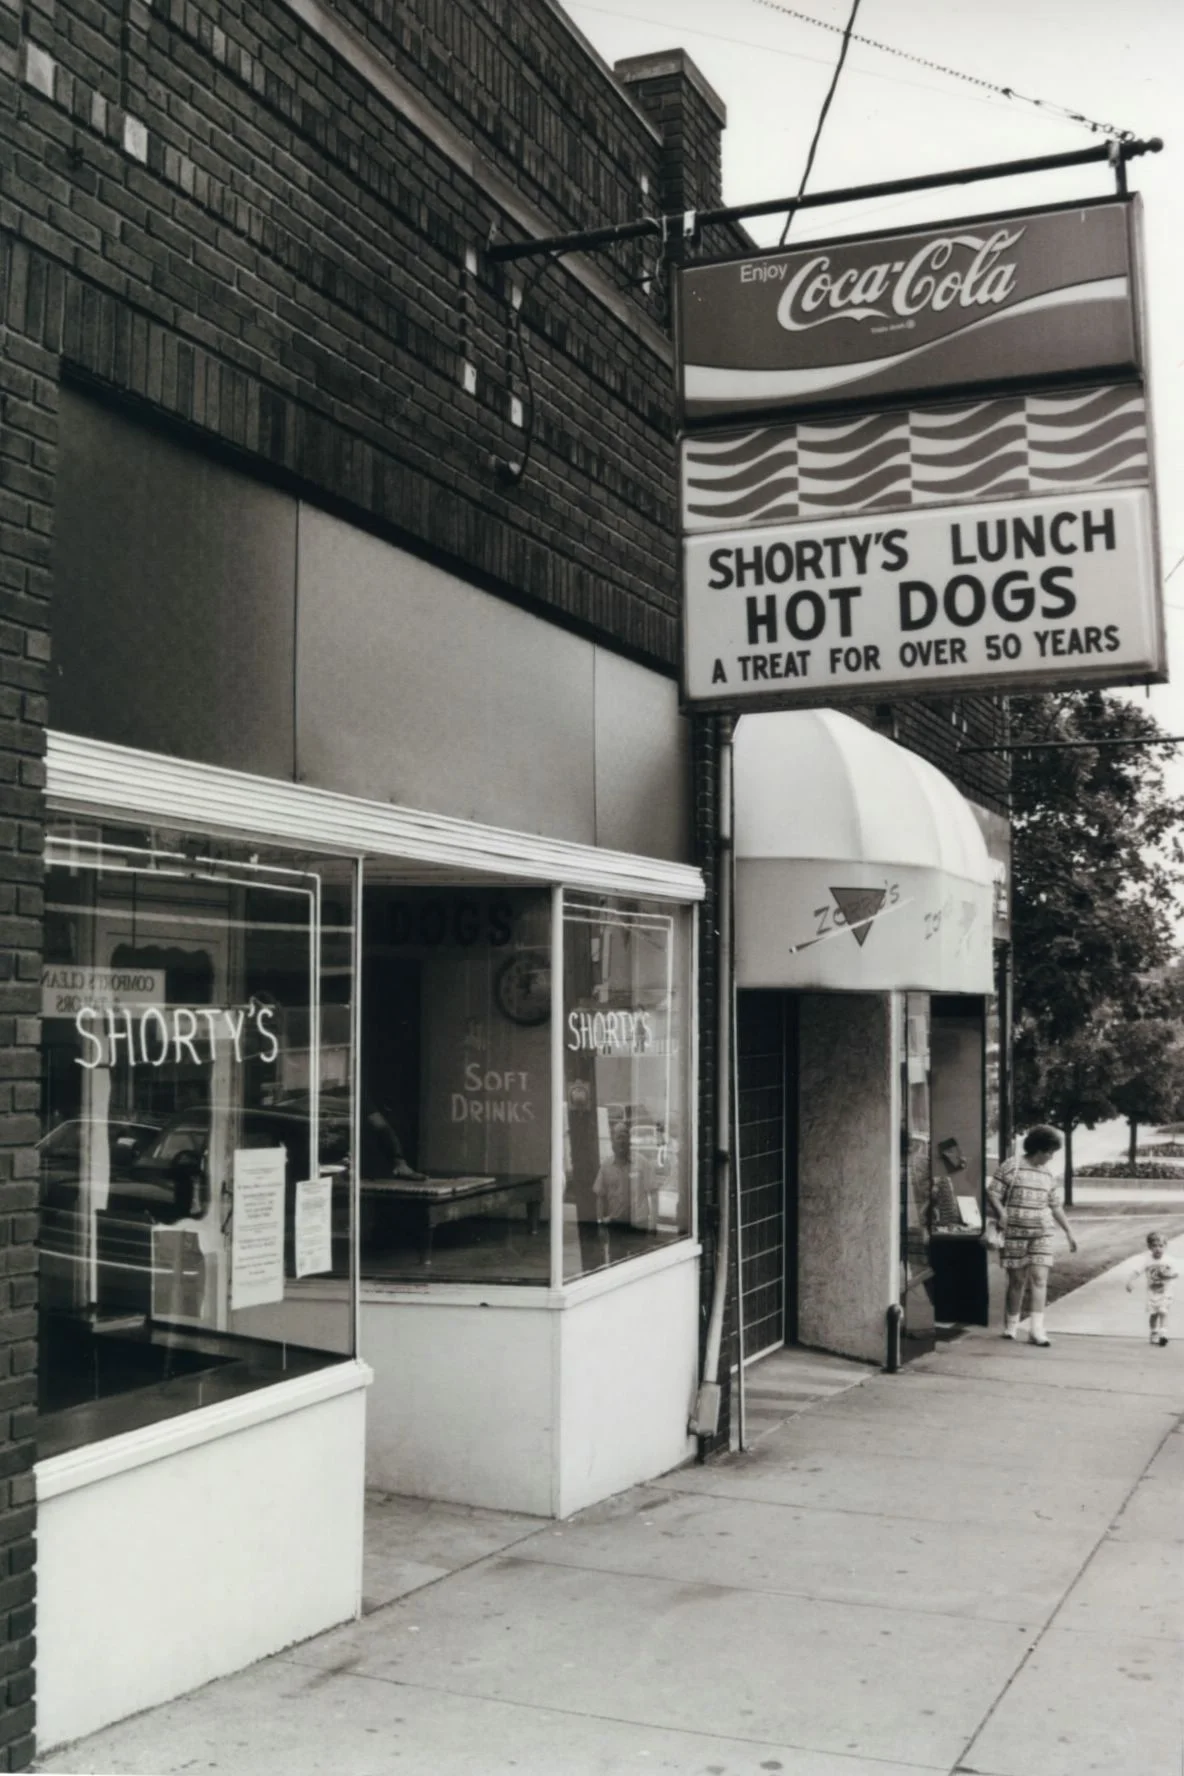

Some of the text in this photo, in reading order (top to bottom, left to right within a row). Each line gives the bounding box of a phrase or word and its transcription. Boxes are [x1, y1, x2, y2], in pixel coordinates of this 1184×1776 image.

[740, 262, 788, 283] Enjoy
[776, 225, 1026, 332] Coca-Cola
[708, 508, 1116, 590] SHORTY'S LUNCH
[746, 566, 1077, 645] HOT DOGS
[712, 625, 1121, 684] A TREAT FOR OVER 50 YEARS
[74, 1004, 279, 1068] SHORTY'S
